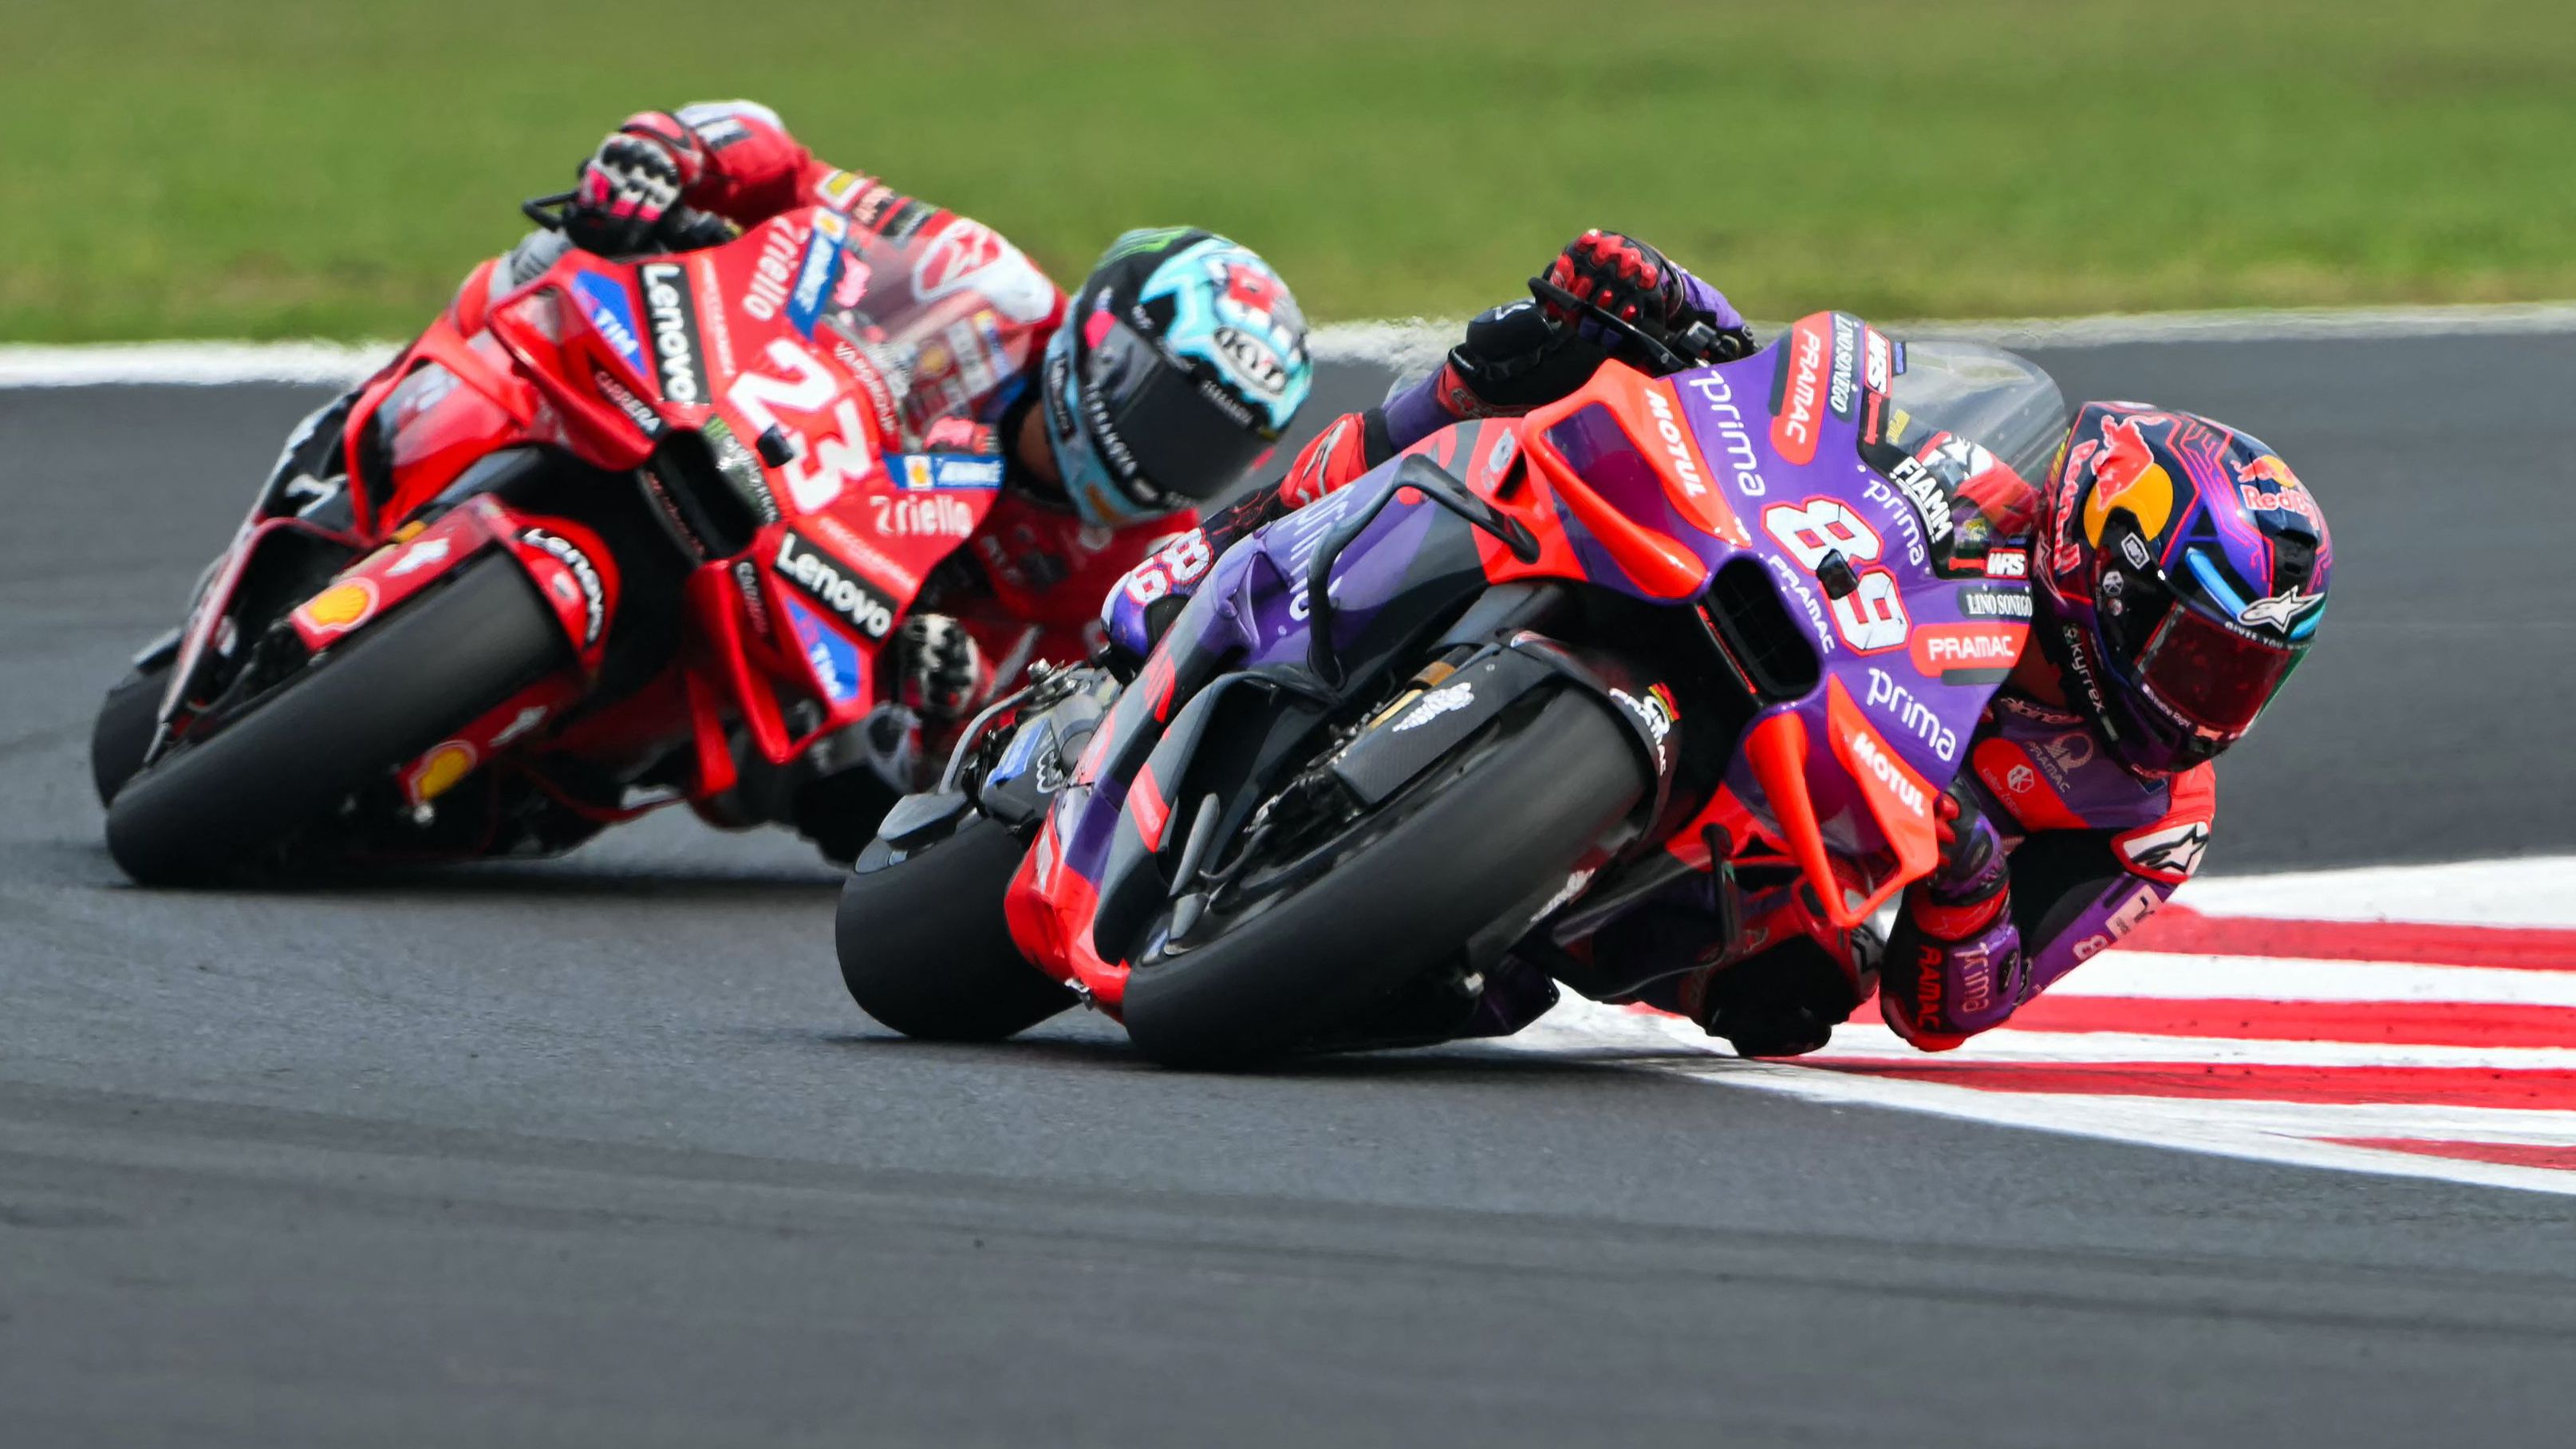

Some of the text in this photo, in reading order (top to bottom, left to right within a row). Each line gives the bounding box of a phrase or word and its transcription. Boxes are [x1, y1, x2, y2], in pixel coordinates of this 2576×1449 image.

[643, 263, 697, 401] Lenovo
[1868, 330, 1887, 394] WRS
[729, 338, 871, 515] 23
[1689, 370, 1765, 497] prima
[1785, 328, 1821, 444] PRAMAC
[1645, 389, 1707, 498] MOTUL
[1864, 480, 1924, 566] prima
[1893, 456, 1953, 541] FIAMM
[776, 532, 892, 638] Lenovo
[1761, 497, 1912, 656] 89
[1768, 555, 1835, 654] PRAMAC
[1966, 594, 1997, 615] LINO
[1986, 552, 2026, 576] WRS
[1927, 636, 2015, 661] PRAMAC
[1868, 667, 1957, 761] prima
[1853, 732, 1925, 816] MOTUL
